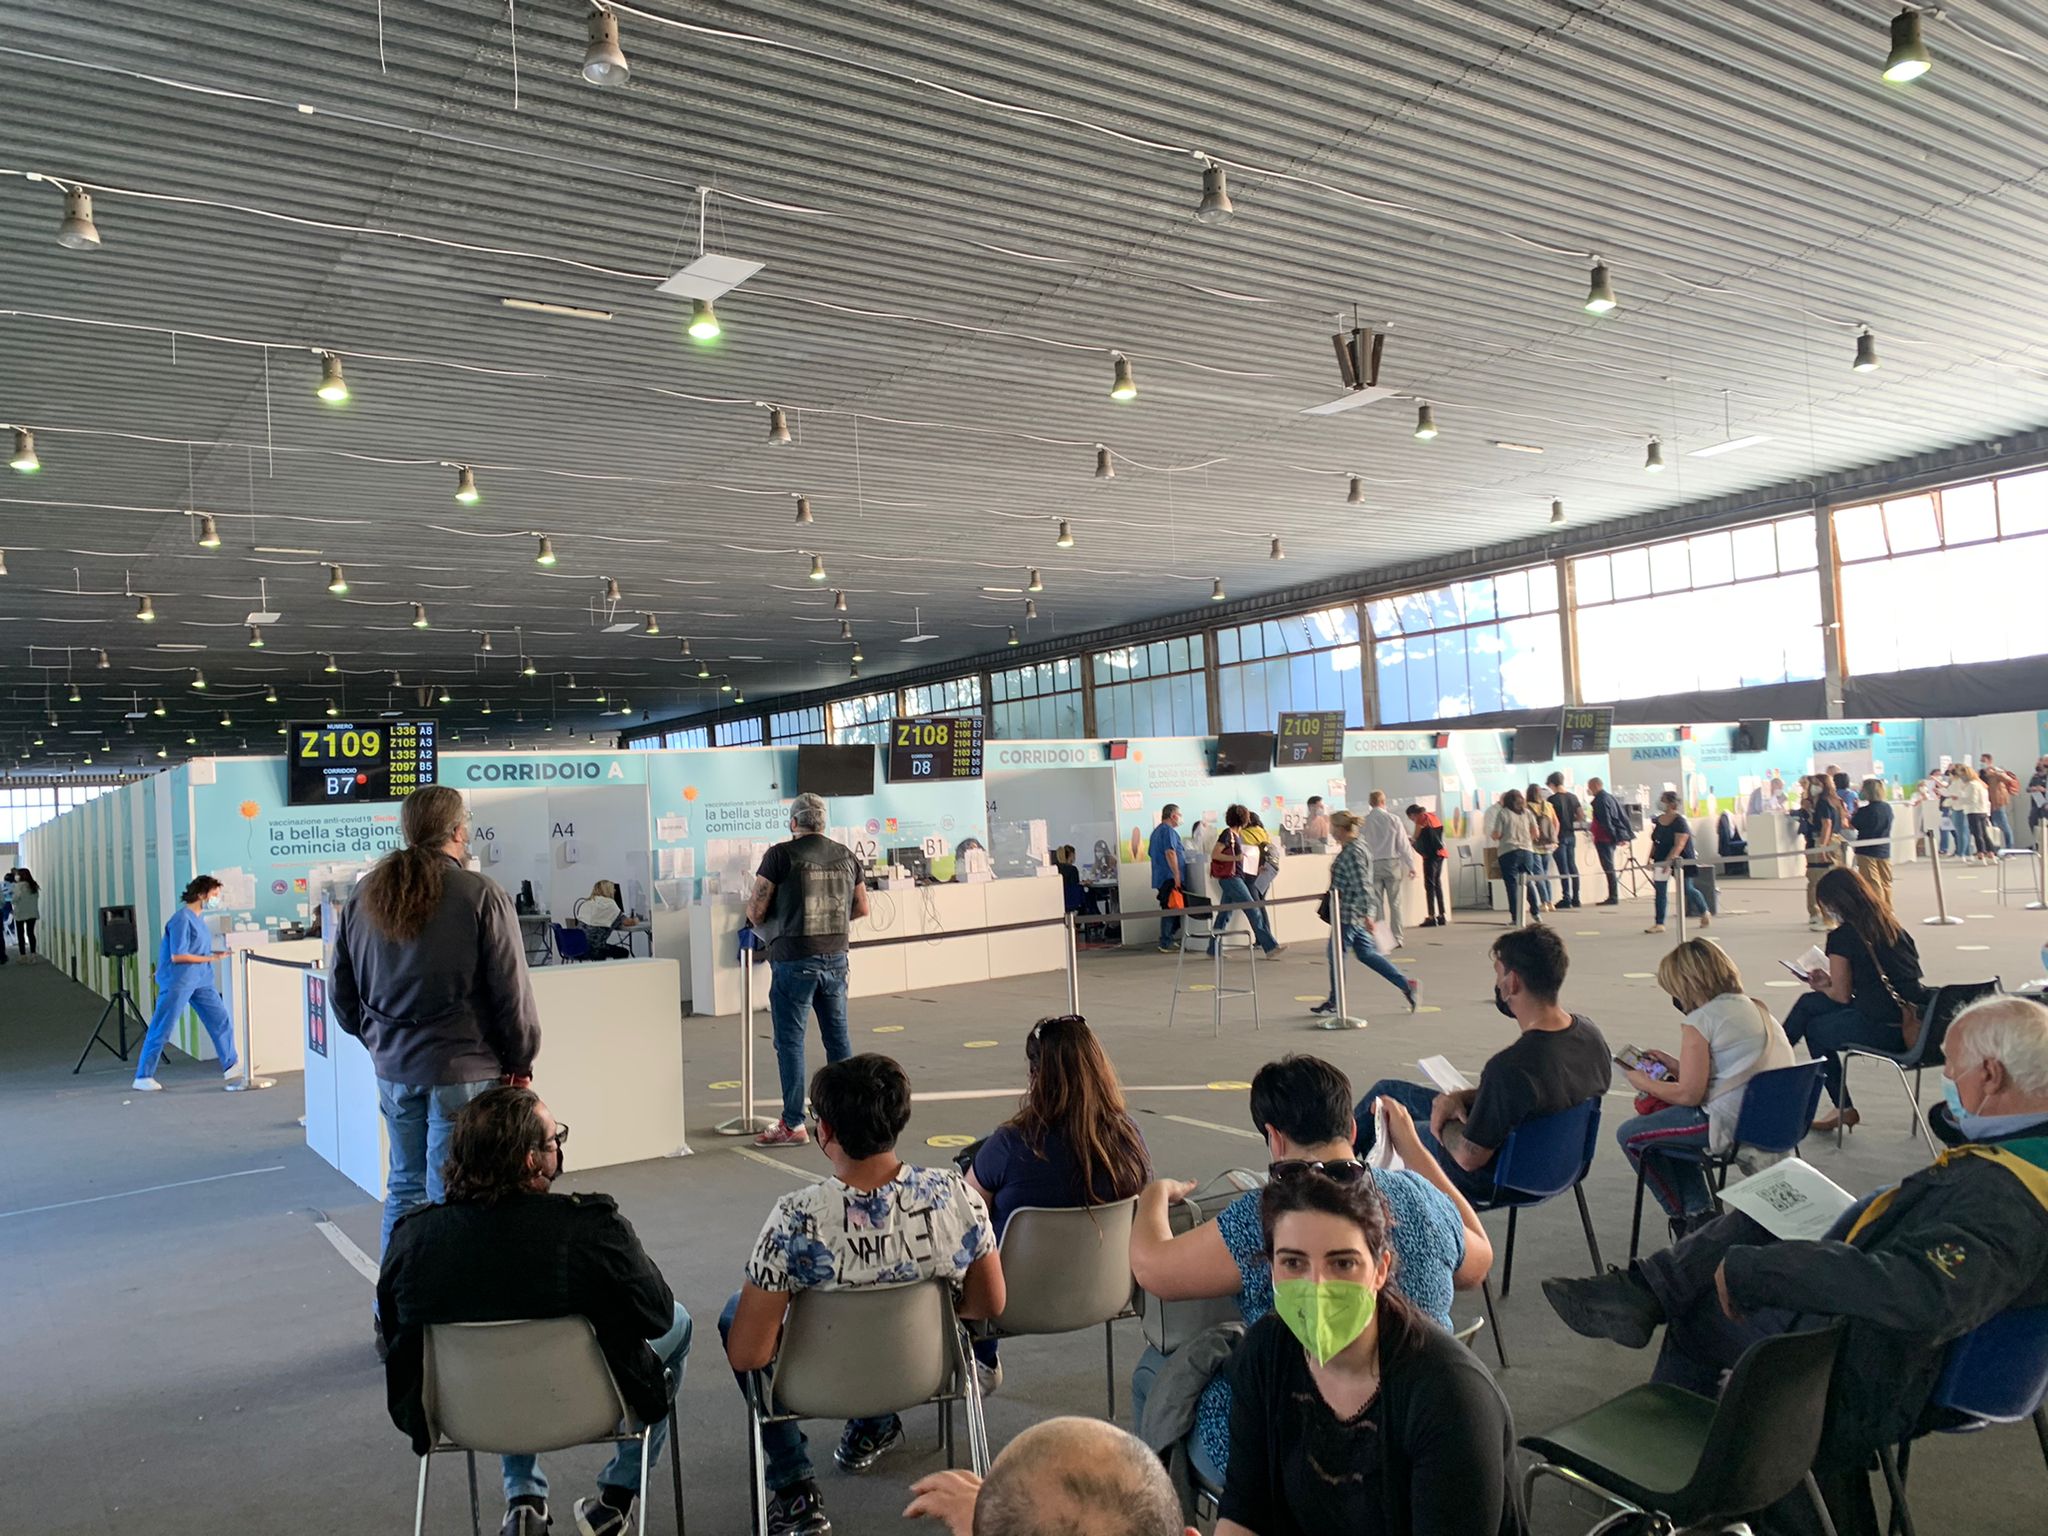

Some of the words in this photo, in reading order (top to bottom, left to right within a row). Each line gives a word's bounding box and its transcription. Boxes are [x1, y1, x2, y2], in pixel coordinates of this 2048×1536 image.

[1284, 718, 1320, 736] Z109
[1565, 713, 1594, 729] Z108
[390, 726, 416, 736] L336
[419, 726, 433, 736] A8
[897, 725, 949, 746] Z108
[301, 731, 380, 758] Z109
[390, 738, 416, 748] Z105
[419, 738, 433, 748] A3
[1354, 739, 1416, 751] CORRIDOIO
[1813, 739, 1870, 752] NAMNE
[390, 750, 416, 760] L335
[419, 750, 433, 760] A2
[1000, 749, 1085, 764] CORRIDOIO
[1293, 748, 1307, 760] B7
[390, 762, 416, 772] Z097
[419, 762, 433, 772] B5
[466, 762, 600, 781] CORRIDOIO
[607, 761, 625, 780] A
[912, 760, 931, 775] D8
[327, 777, 355, 795] B7
[390, 774, 416, 784] Z096
[419, 773, 433, 783] B5
[705, 809, 717, 820] la
[720, 807, 750, 820] bella
[753, 806, 792, 819] stagio
[269, 817, 322, 827] vaccinazione
[705, 819, 762, 833] comincia
[765, 818, 780, 829] da
[1285, 814, 1301, 828] B2
[270, 827, 284, 841] la
[290, 826, 330, 840] bella
[335, 823, 403, 839] stagione
[475, 827, 496, 841] A6
[552, 822, 575, 838] A4
[270, 840, 346, 856] comincia
[352, 838, 371, 852] da
[855, 840, 877, 858] A2
[925, 838, 943, 856] B1
